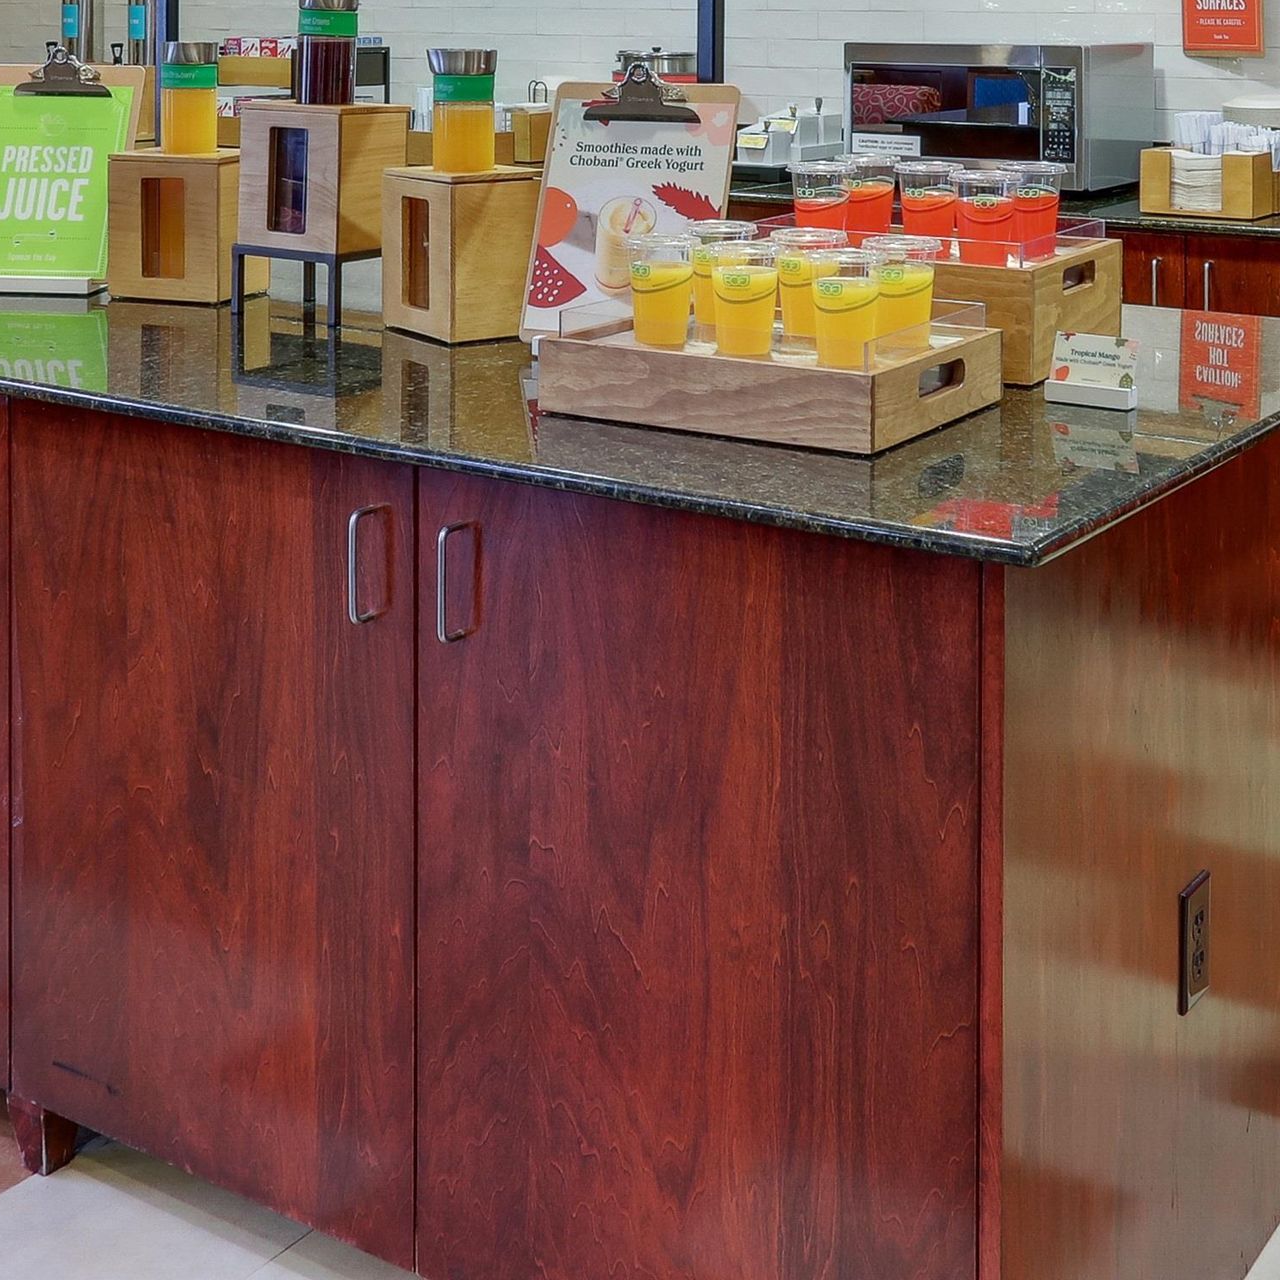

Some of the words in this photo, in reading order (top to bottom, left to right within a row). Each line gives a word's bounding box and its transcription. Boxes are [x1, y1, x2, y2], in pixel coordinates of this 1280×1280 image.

[575, 141, 638, 155] Smoothies
[640, 144, 674, 156] made
[676, 145, 702, 157] with
[1, 145, 93, 173] PRESSED
[626, 157, 662, 169] Greek
[665, 159, 704, 173] Yogurt
[1070, 348, 1097, 359] Tropical
[1099, 352, 1121, 361] Mango
